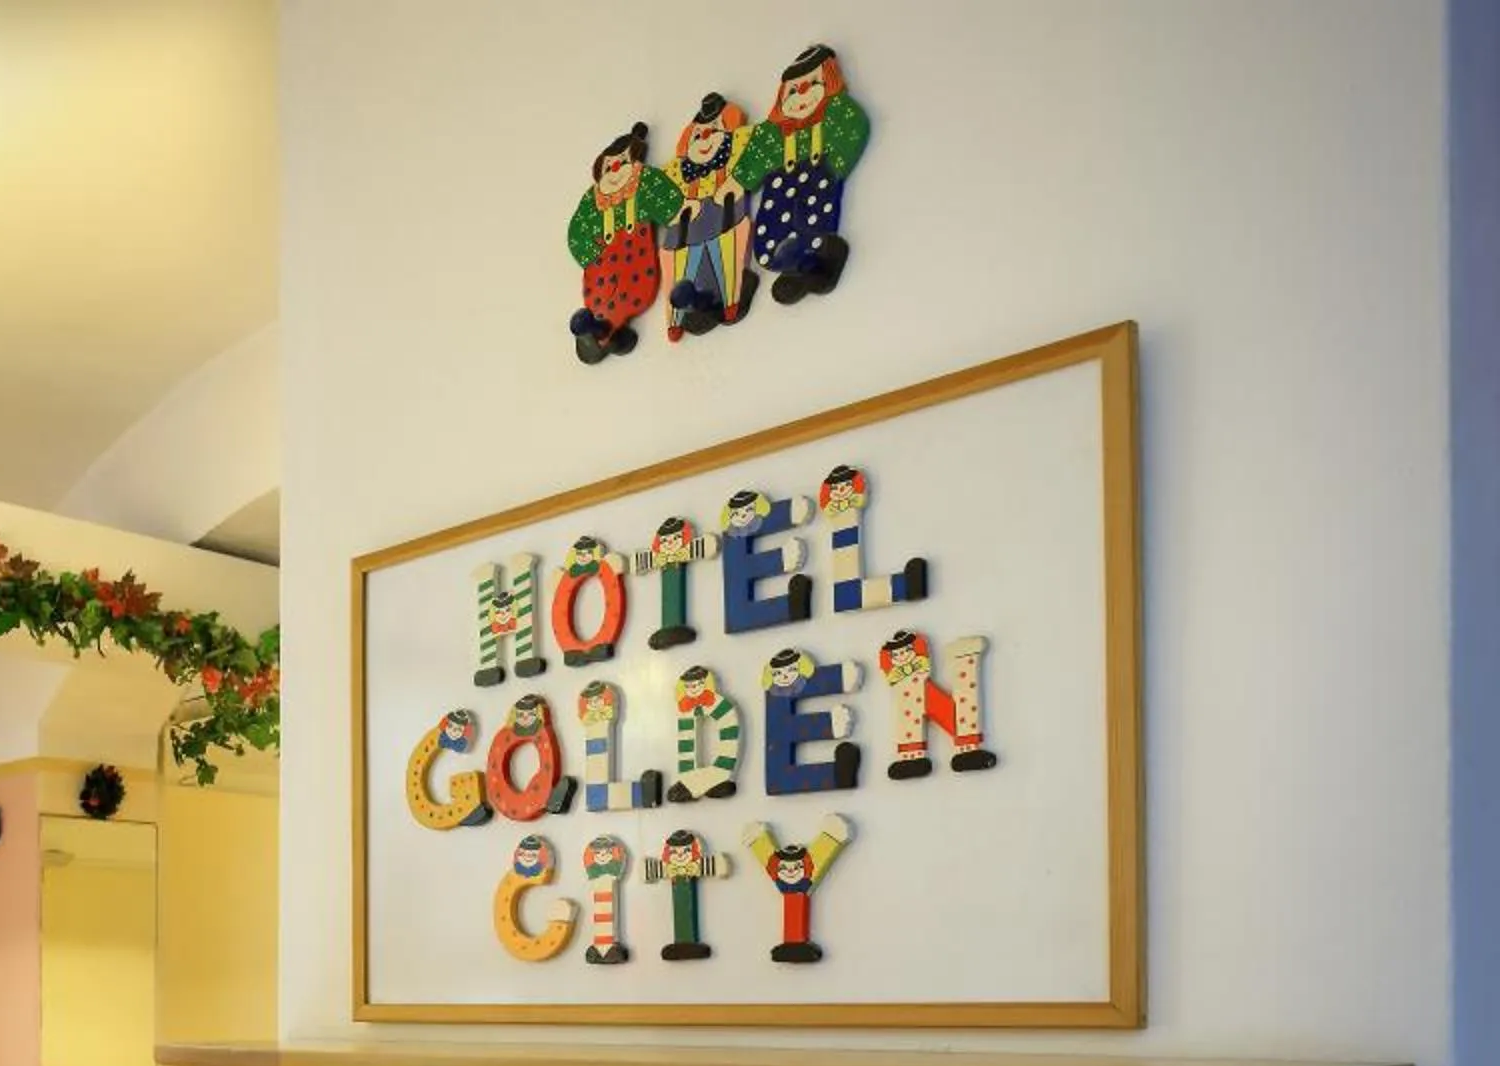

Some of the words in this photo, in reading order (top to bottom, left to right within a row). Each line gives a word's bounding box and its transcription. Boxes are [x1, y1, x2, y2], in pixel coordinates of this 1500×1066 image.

[473, 465, 927, 686] HOTEL
[407, 630, 997, 830] GOLDEN
[493, 812, 856, 963] CITY
